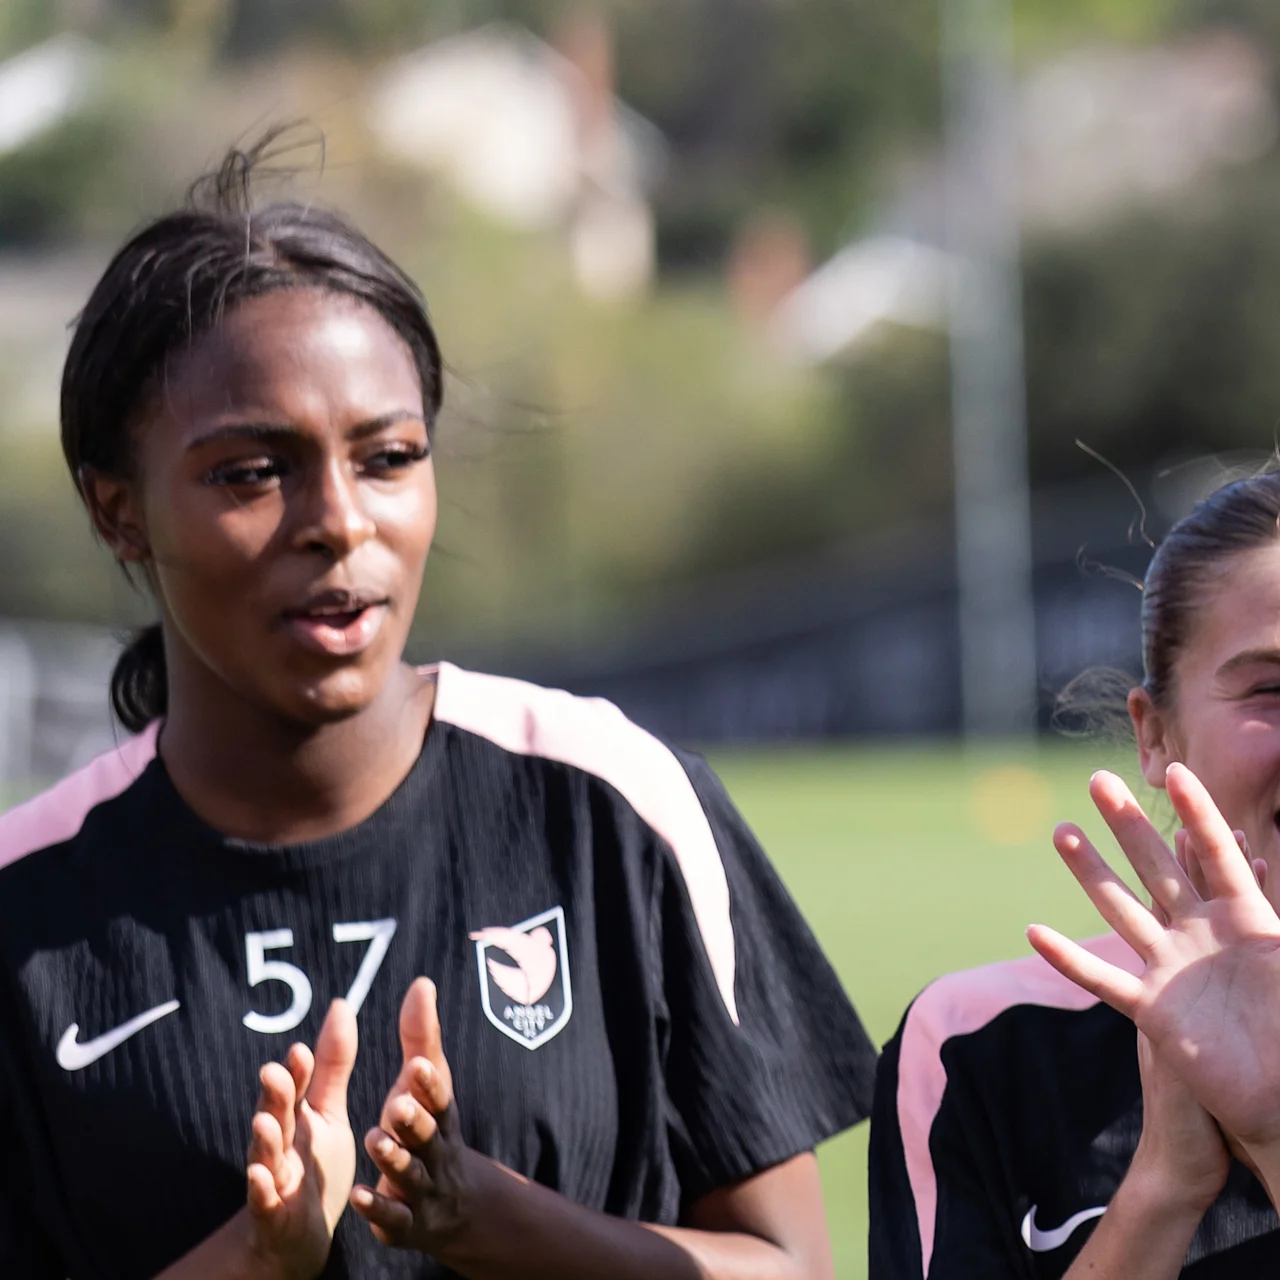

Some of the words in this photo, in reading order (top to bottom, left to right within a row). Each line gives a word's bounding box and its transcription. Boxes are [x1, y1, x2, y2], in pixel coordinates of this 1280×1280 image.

[242, 917, 398, 1034] 57
[503, 1004, 555, 1020] ANGEL
[512, 1015, 546, 1031] CITY
